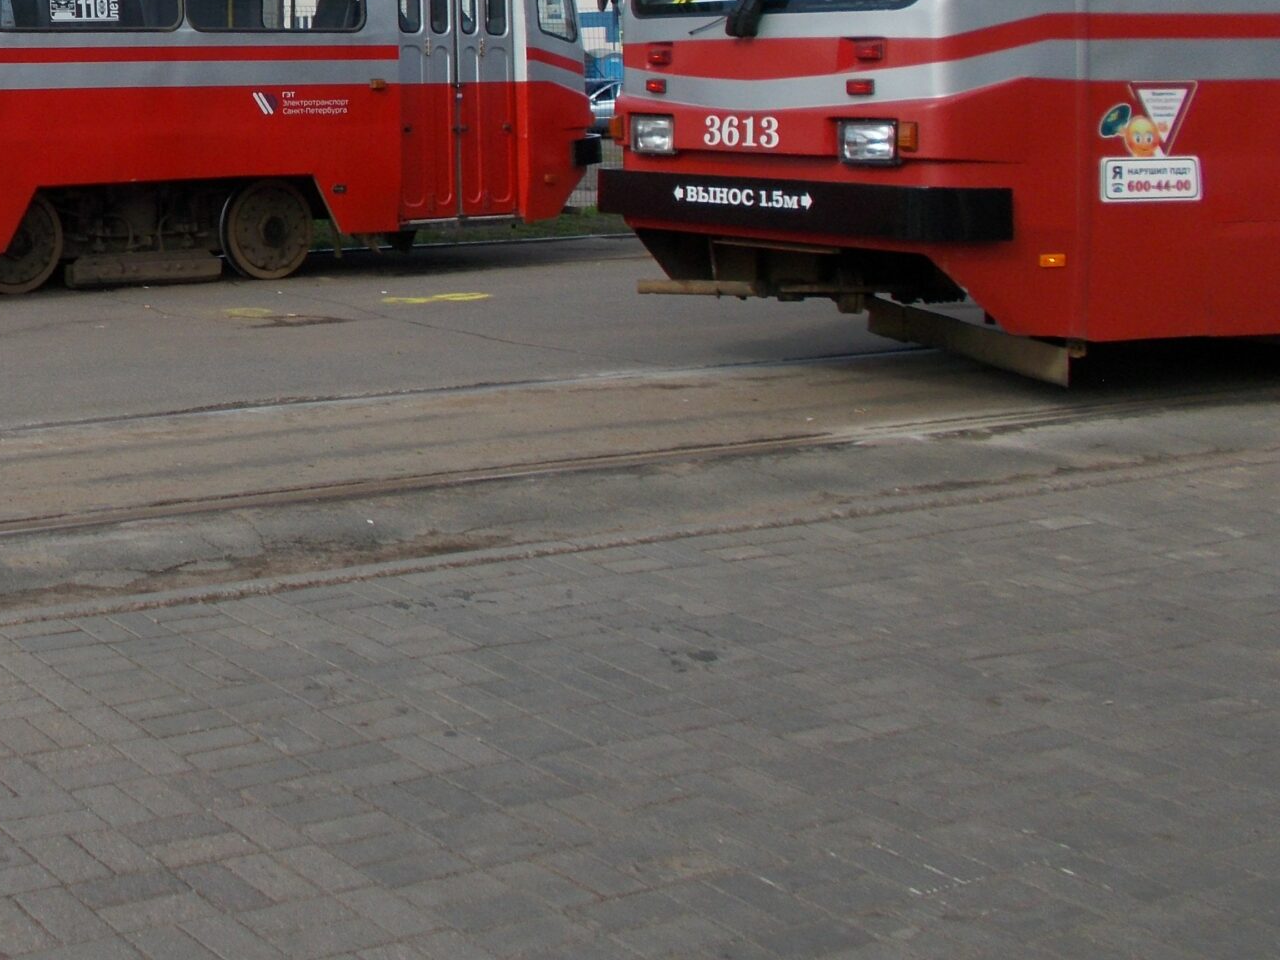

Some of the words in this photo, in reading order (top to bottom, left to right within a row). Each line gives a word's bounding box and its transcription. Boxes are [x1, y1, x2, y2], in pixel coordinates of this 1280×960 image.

[282, 99, 349, 107] Электротранспорт
[282, 107, 348, 115] Санкт-Петербурга
[704, 115, 779, 148] 3613
[1112, 166, 1123, 179] Я
[1127, 167, 1168, 175] НАРУШИЛ
[1127, 180, 1192, 192] 600-44-00
[685, 185, 754, 206] ВЫНОС
[759, 190, 799, 209] 1.5м
